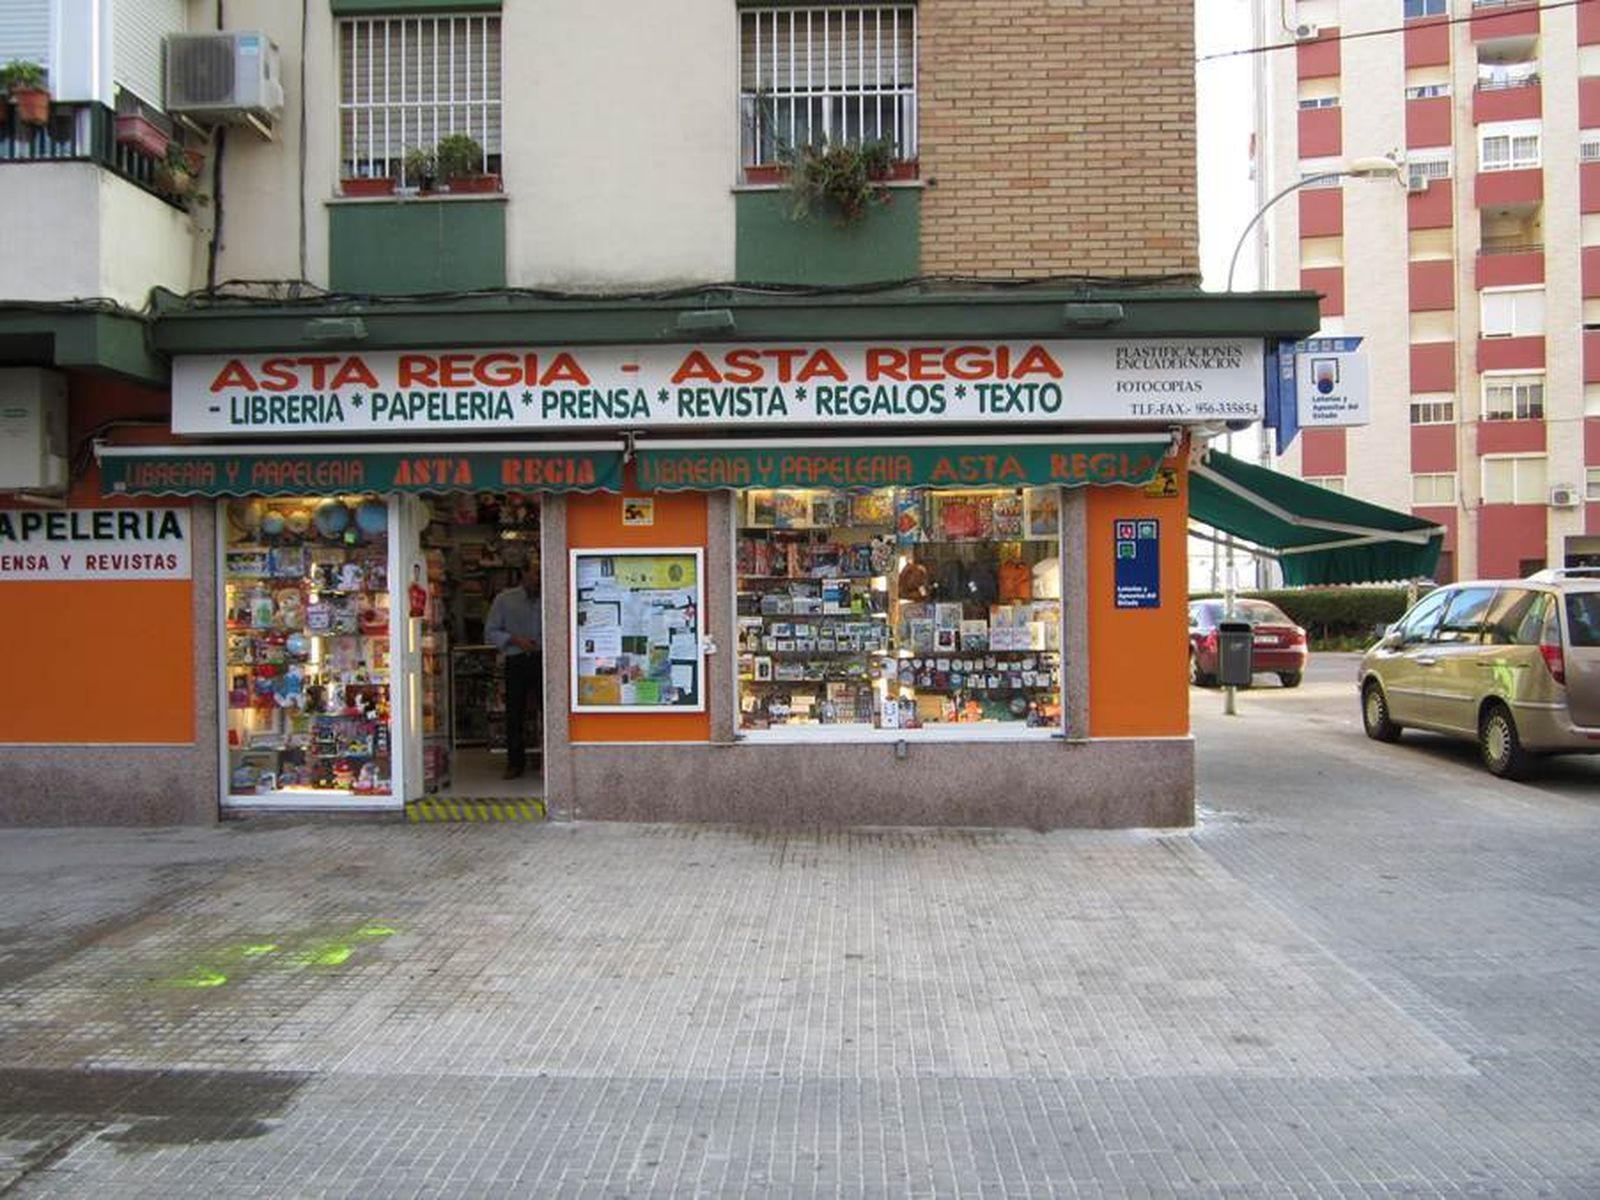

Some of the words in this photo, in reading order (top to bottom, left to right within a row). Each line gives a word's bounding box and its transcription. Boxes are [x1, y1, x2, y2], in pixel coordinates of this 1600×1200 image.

[1115, 346, 1243, 357] PLASTIFICACIONES
[209, 355, 379, 392] ASTA
[398, 352, 591, 387] REGIA
[671, 348, 848, 384] ASTA
[866, 345, 1064, 382] REGIA
[230, 394, 345, 425] LIBRERIA
[371, 391, 515, 422] PAPELERIA
[541, 388, 652, 420] PRENSA
[677, 385, 788, 418] REVISTA
[815, 383, 947, 416] REGALOS
[977, 381, 1063, 414] TEXTO
[226, 461, 240, 485] Y
[252, 459, 366, 486] PAPELERIA
[393, 458, 473, 486] ASTA
[502, 458, 597, 486] REGIA
[757, 455, 775, 482] Y
[780, 455, 913, 482] PAPELERIA
[932, 454, 1027, 482] ASTA
[61, 554, 72, 571] Y
[86, 553, 178, 570] REVISTAS
